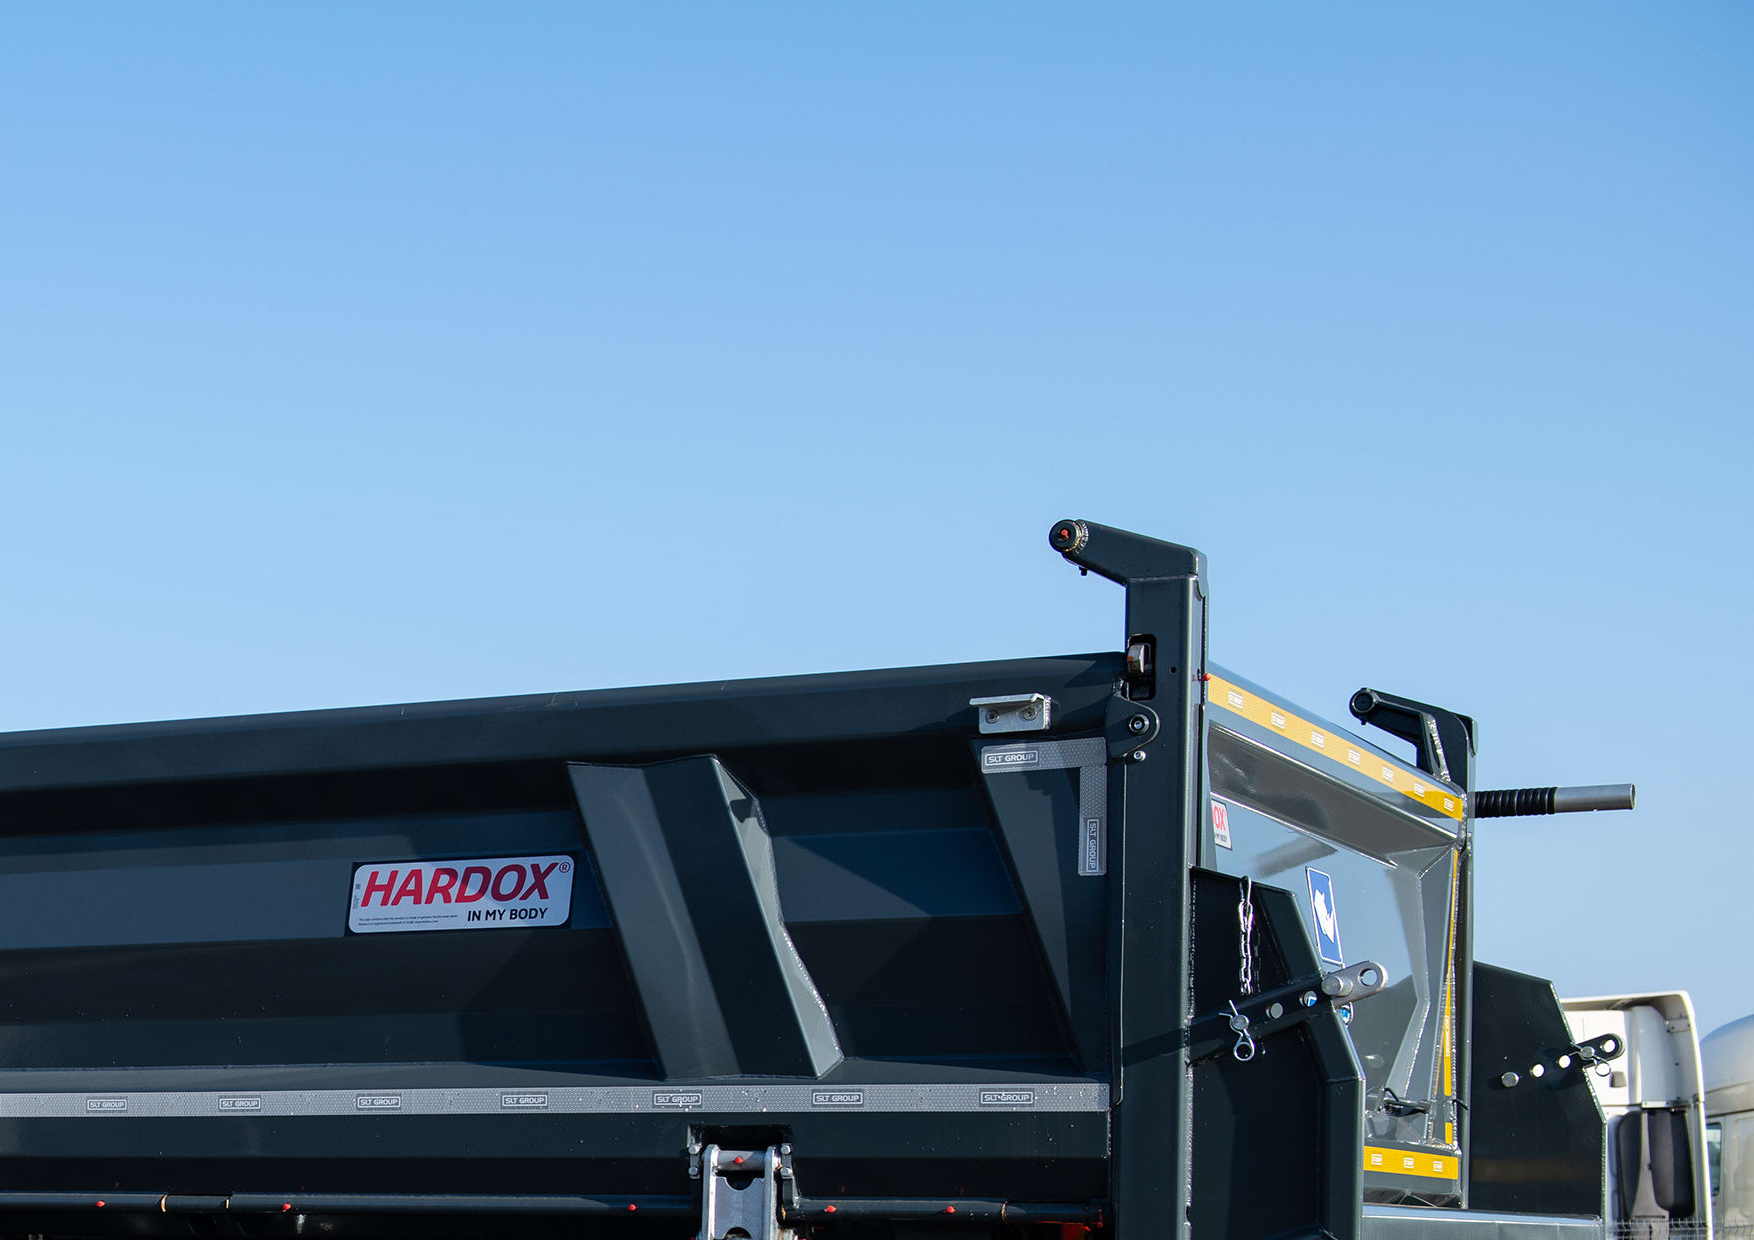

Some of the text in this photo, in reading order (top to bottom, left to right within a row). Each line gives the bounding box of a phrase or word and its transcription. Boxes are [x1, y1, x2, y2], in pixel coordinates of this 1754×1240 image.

[988, 753, 1034, 763] SLT GROUP
[1088, 822, 1097, 869] SLT GROUP
[467, 909, 482, 922] IN
[485, 908, 506, 921] MY
[509, 907, 548, 920] BODY
